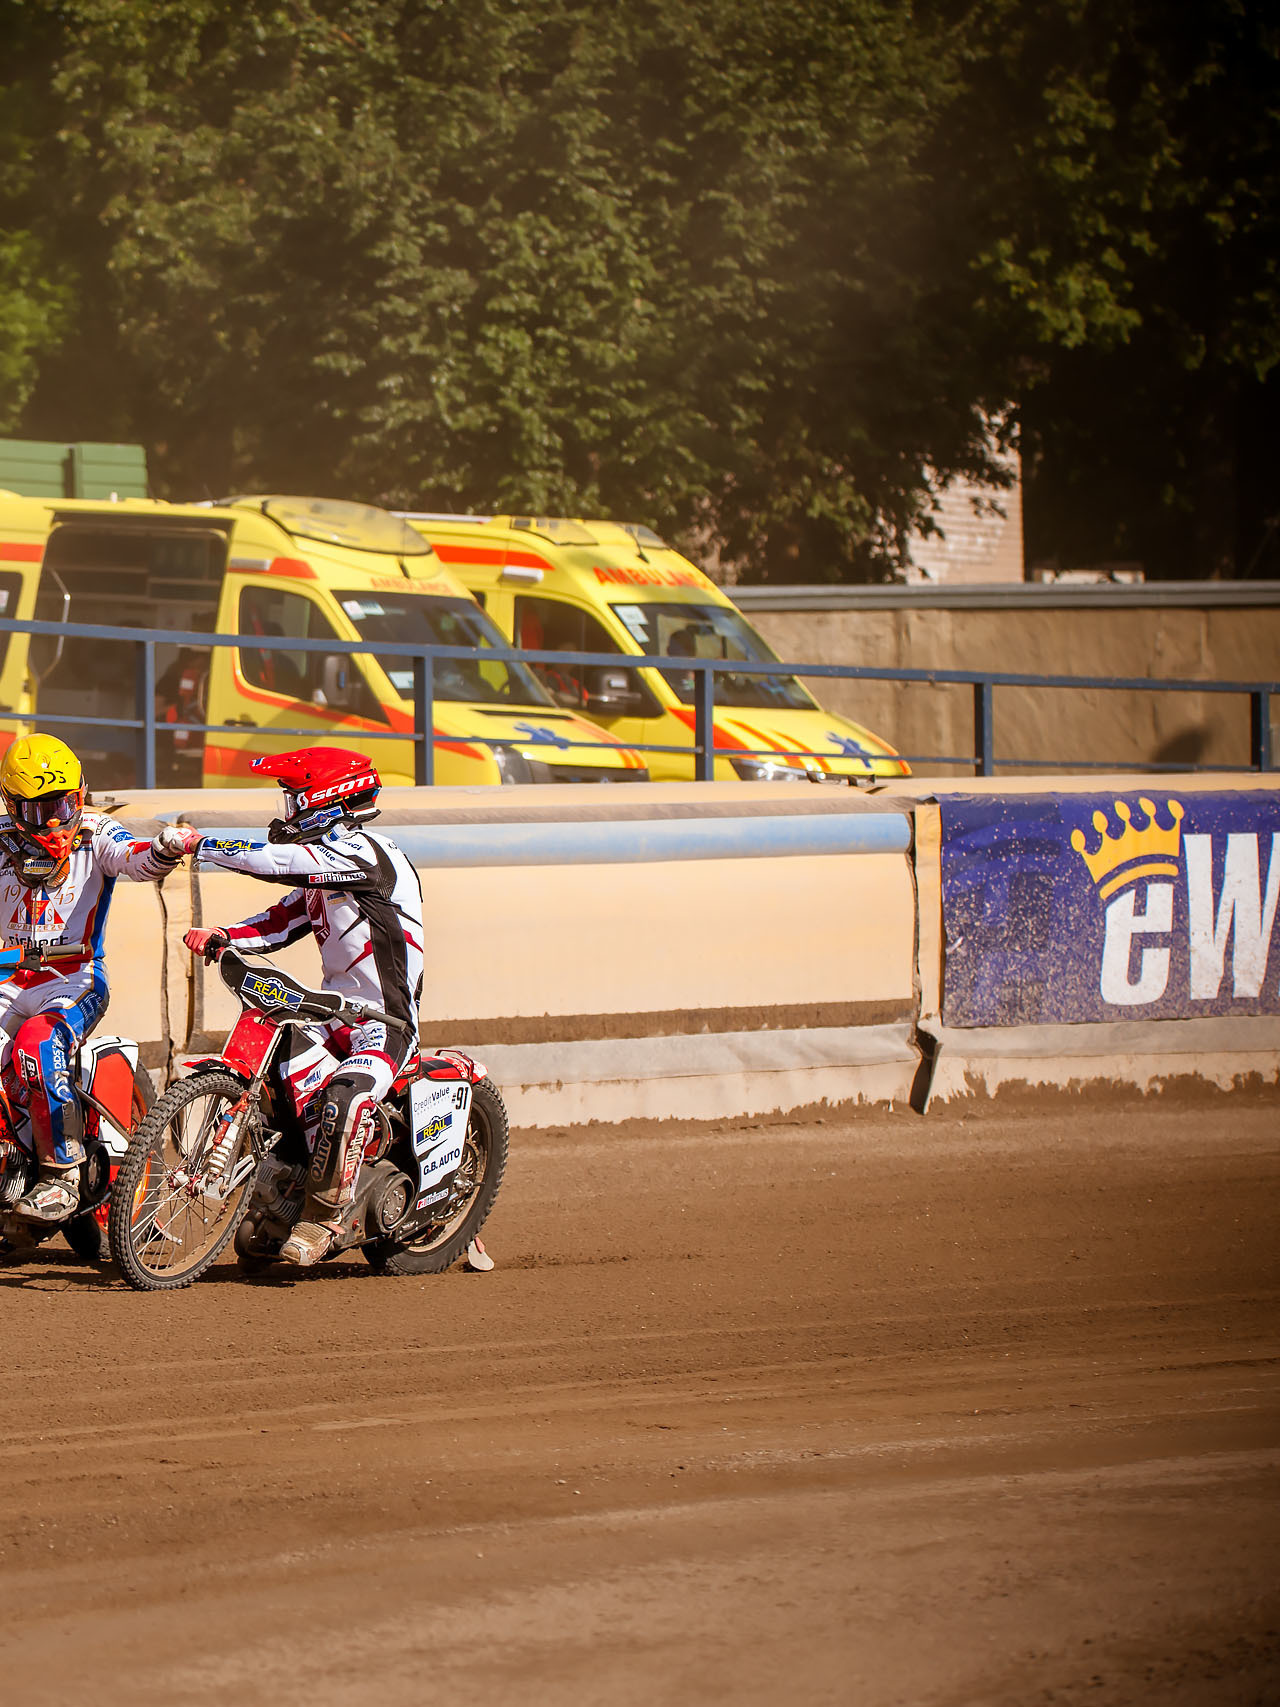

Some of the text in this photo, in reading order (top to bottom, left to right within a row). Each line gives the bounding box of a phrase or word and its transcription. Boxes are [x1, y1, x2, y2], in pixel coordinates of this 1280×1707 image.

[310, 774, 378, 803] SCOTT
[215, 840, 253, 851] REALL
[4, 884, 21, 904] 19
[53, 886, 76, 905] 45
[253, 980, 289, 1004] REALL
[423, 1118, 447, 1139] REALL
[439, 1148, 461, 1168] AUTO
